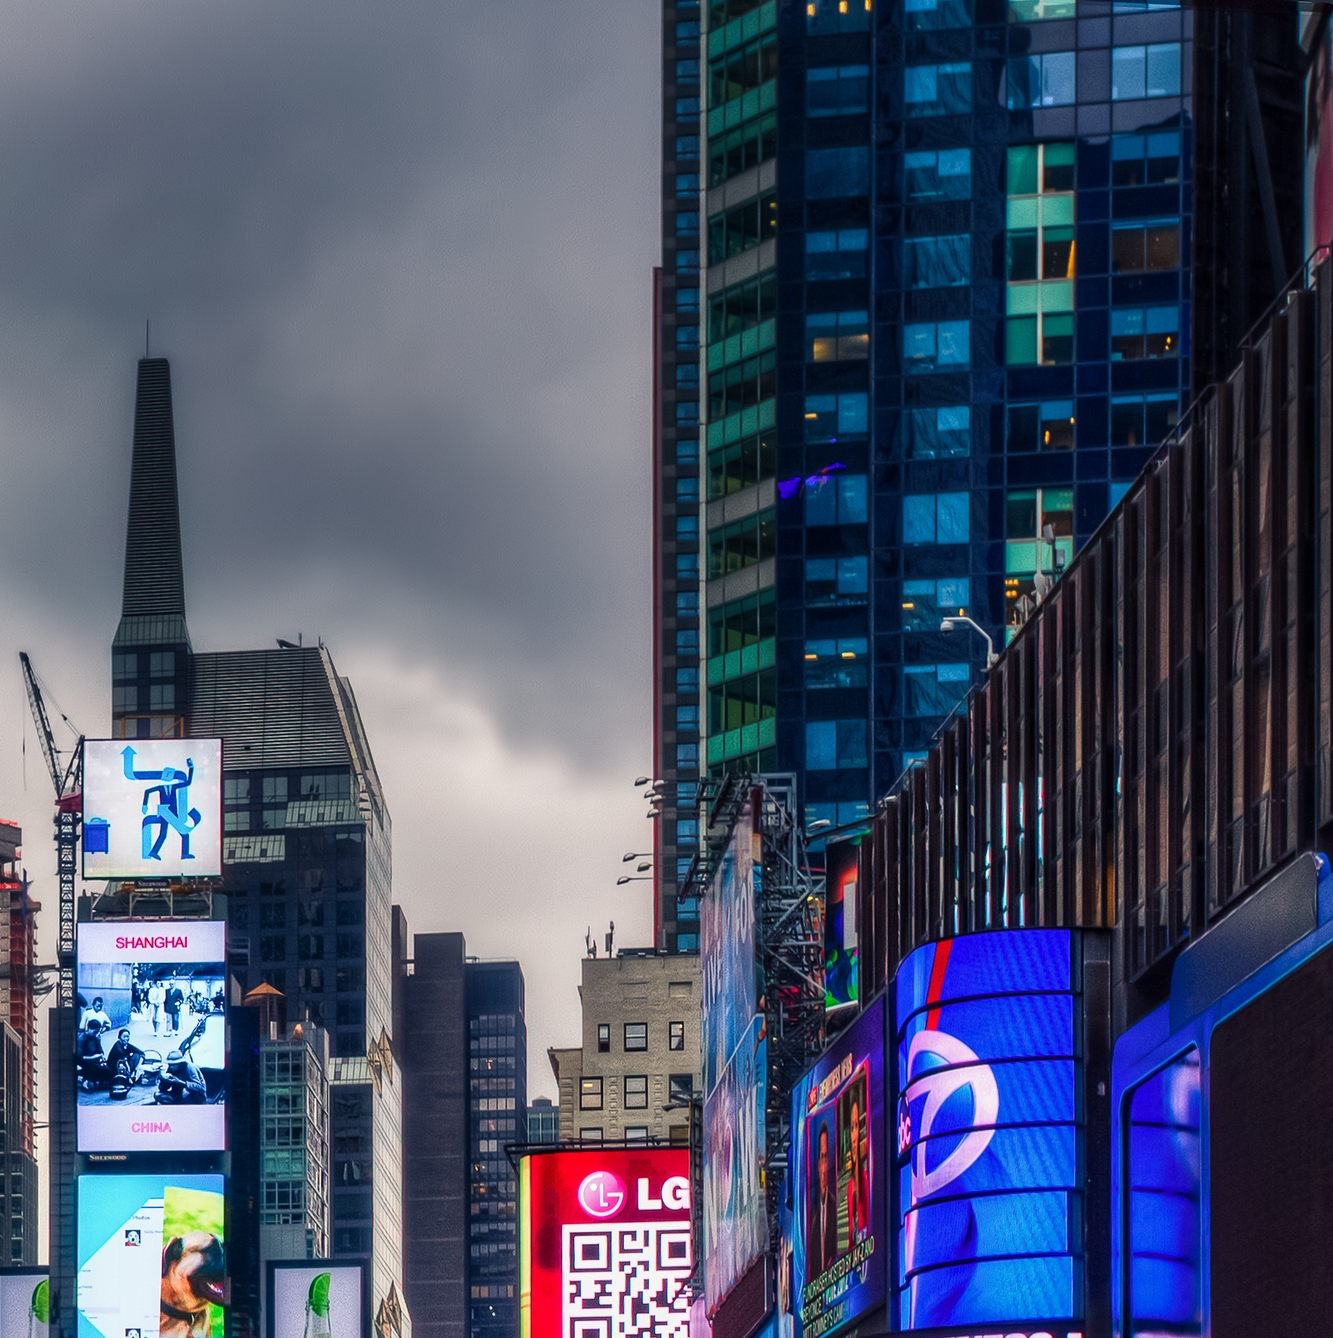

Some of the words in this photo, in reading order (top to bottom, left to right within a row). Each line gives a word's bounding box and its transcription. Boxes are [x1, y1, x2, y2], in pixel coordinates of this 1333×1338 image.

[115, 935, 188, 949] SHANGHAI
[131, 1121, 172, 1133] CHINA
[637, 1177, 690, 1210] LG
